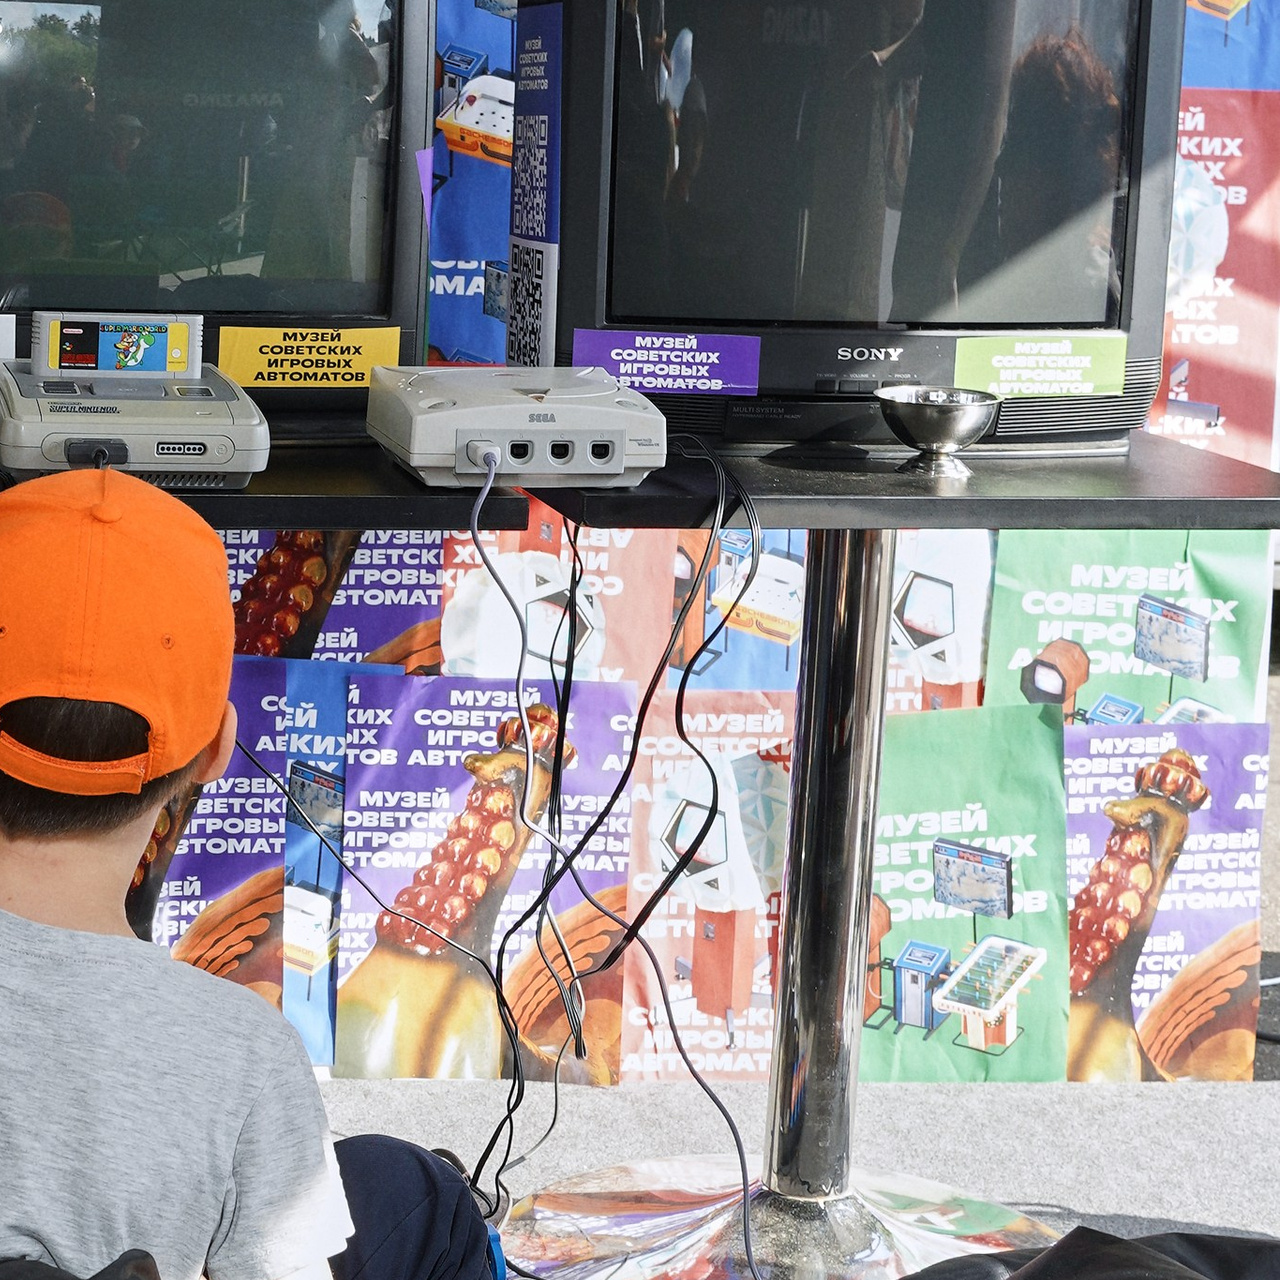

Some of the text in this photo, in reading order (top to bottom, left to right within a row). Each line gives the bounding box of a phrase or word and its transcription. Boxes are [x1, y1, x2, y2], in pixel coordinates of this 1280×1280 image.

[122, 324, 143, 333] MARIO
[144, 324, 167, 333] WORLD
[282, 328, 342, 342] МУЗЕЙ
[635, 334, 698, 350] МУЗЕЙ
[1014, 339, 1073, 355] МУЗЕЙ
[258, 345, 363, 356] СОВЕТСКИХ
[609, 349, 721, 365] СОВЕТСКИХ
[837, 347, 904, 362] SONY
[267, 358, 353, 369] ИГРОВЫХ
[991, 354, 1092, 369] СОВЕТСКИХ
[253, 371, 366, 382] АВТОМАТОВ
[619, 362, 710, 378] ИГРОВЫХ
[999, 368, 1082, 382] ИГРОВЫХ
[987, 381, 1094, 395] АВТОМАТОВ
[528, 413, 556, 423] SEGA
[1071, 562, 1194, 591] МУЗЕЙ
[313, 627, 358, 649] ЗЕЙ
[450, 688, 541, 708] МУЗЕЙ
[682, 709, 785, 733] МУЗЕЙ
[1090, 732, 1177, 755] МУЗЕЙ
[1069, 777, 1136, 795] ИГРО
[360, 789, 450, 809] МУЗЕЙ
[158, 877, 201, 897] ЗЕЙ
[1142, 931, 1185, 952] ЗЕЙ
